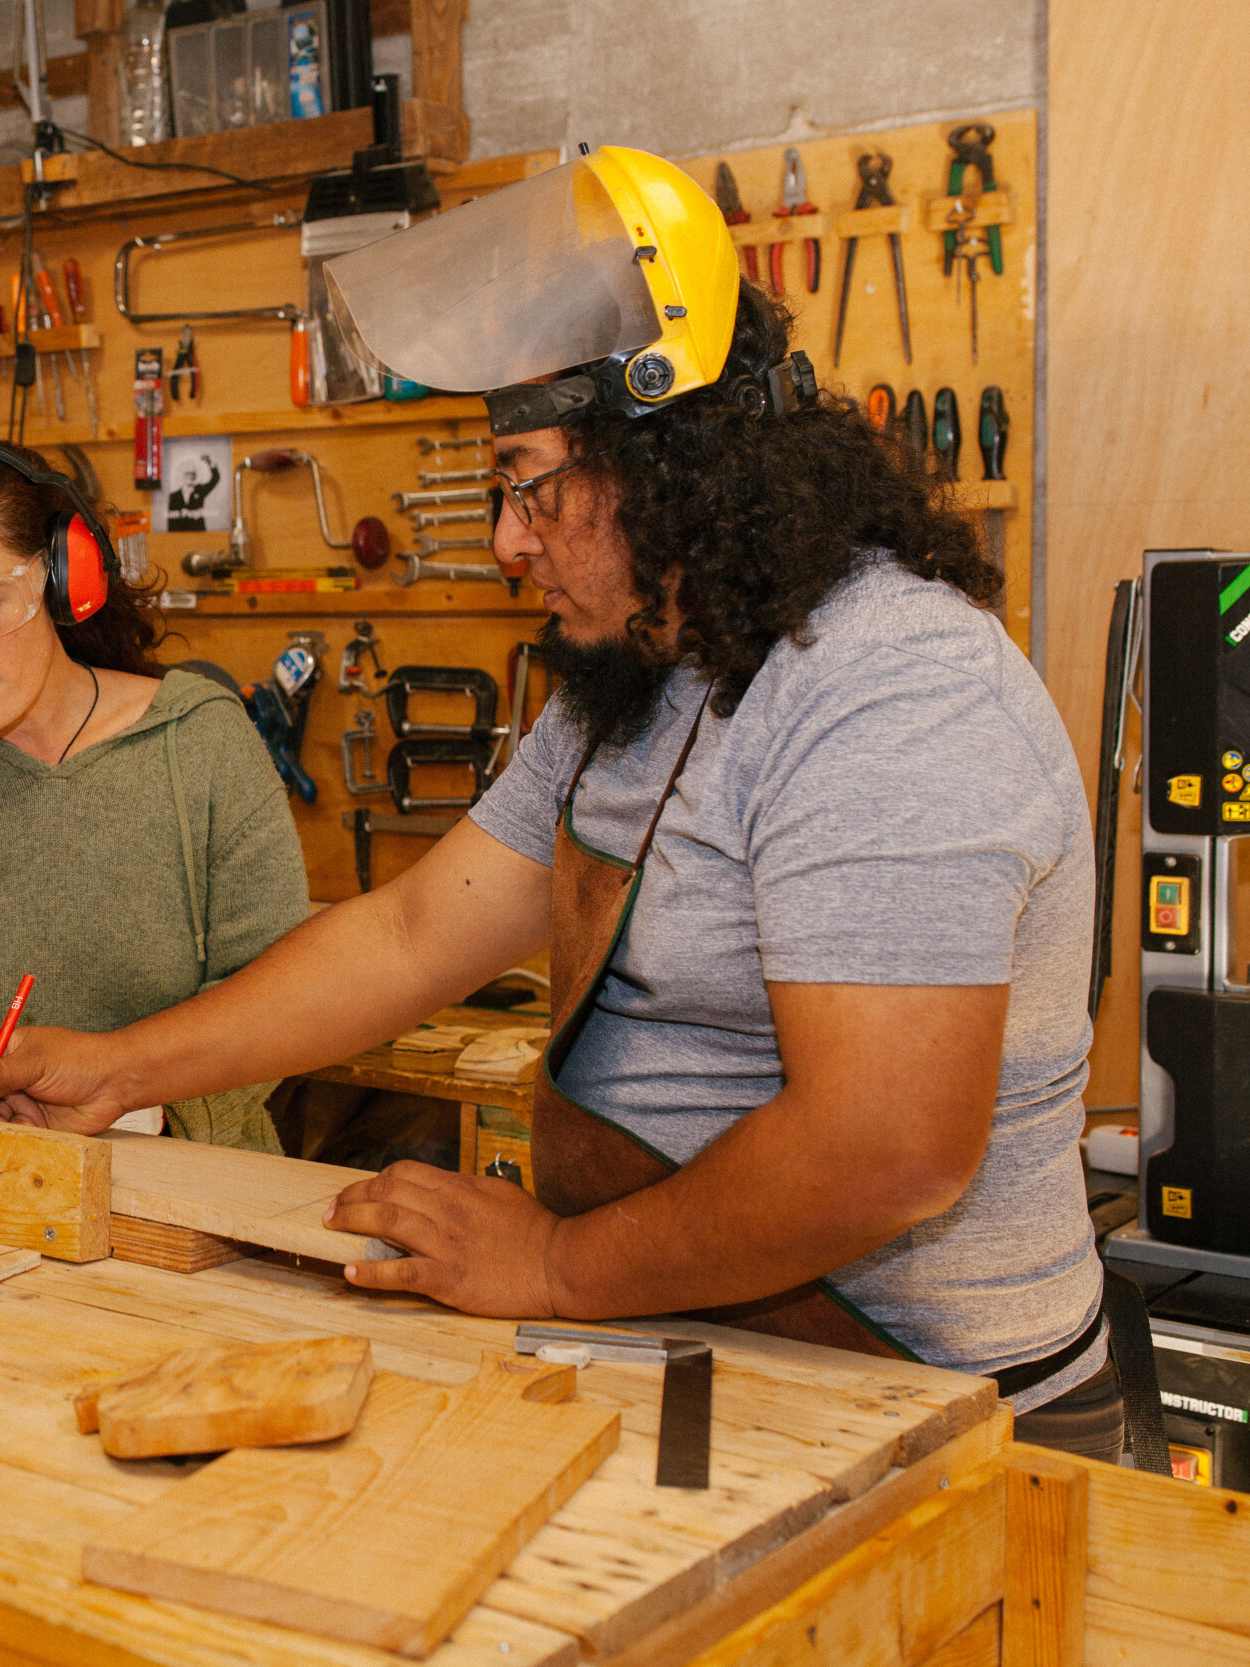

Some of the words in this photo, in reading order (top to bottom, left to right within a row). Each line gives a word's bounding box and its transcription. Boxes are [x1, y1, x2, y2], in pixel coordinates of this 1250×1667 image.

[1229, 612, 1250, 643] CON
[11, 995, 24, 1010] HB
[1160, 1390, 1243, 1422] NSTRUCTOR
